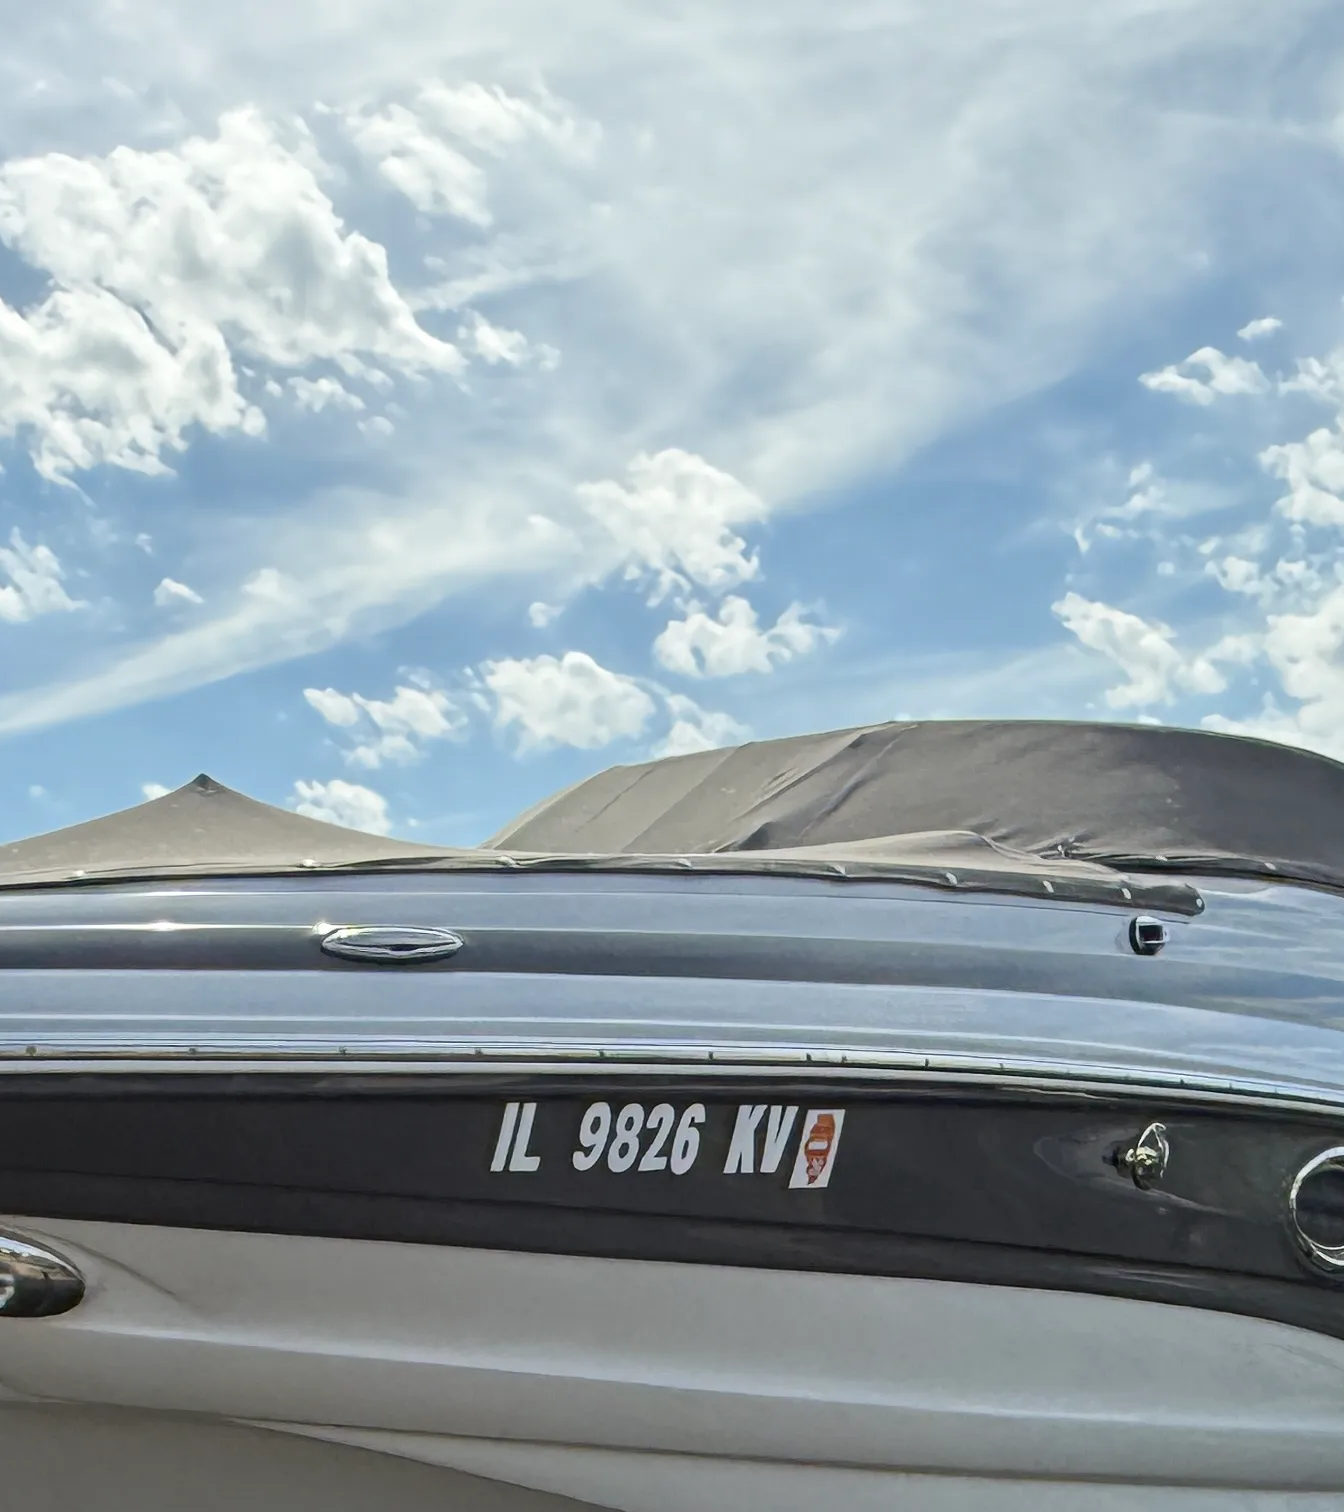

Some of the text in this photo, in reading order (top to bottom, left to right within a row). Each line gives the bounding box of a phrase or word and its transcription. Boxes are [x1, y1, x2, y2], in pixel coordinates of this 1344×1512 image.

[490, 1101, 541, 1172] IL
[572, 1101, 706, 1175] 9826
[722, 1104, 799, 1174] KV
